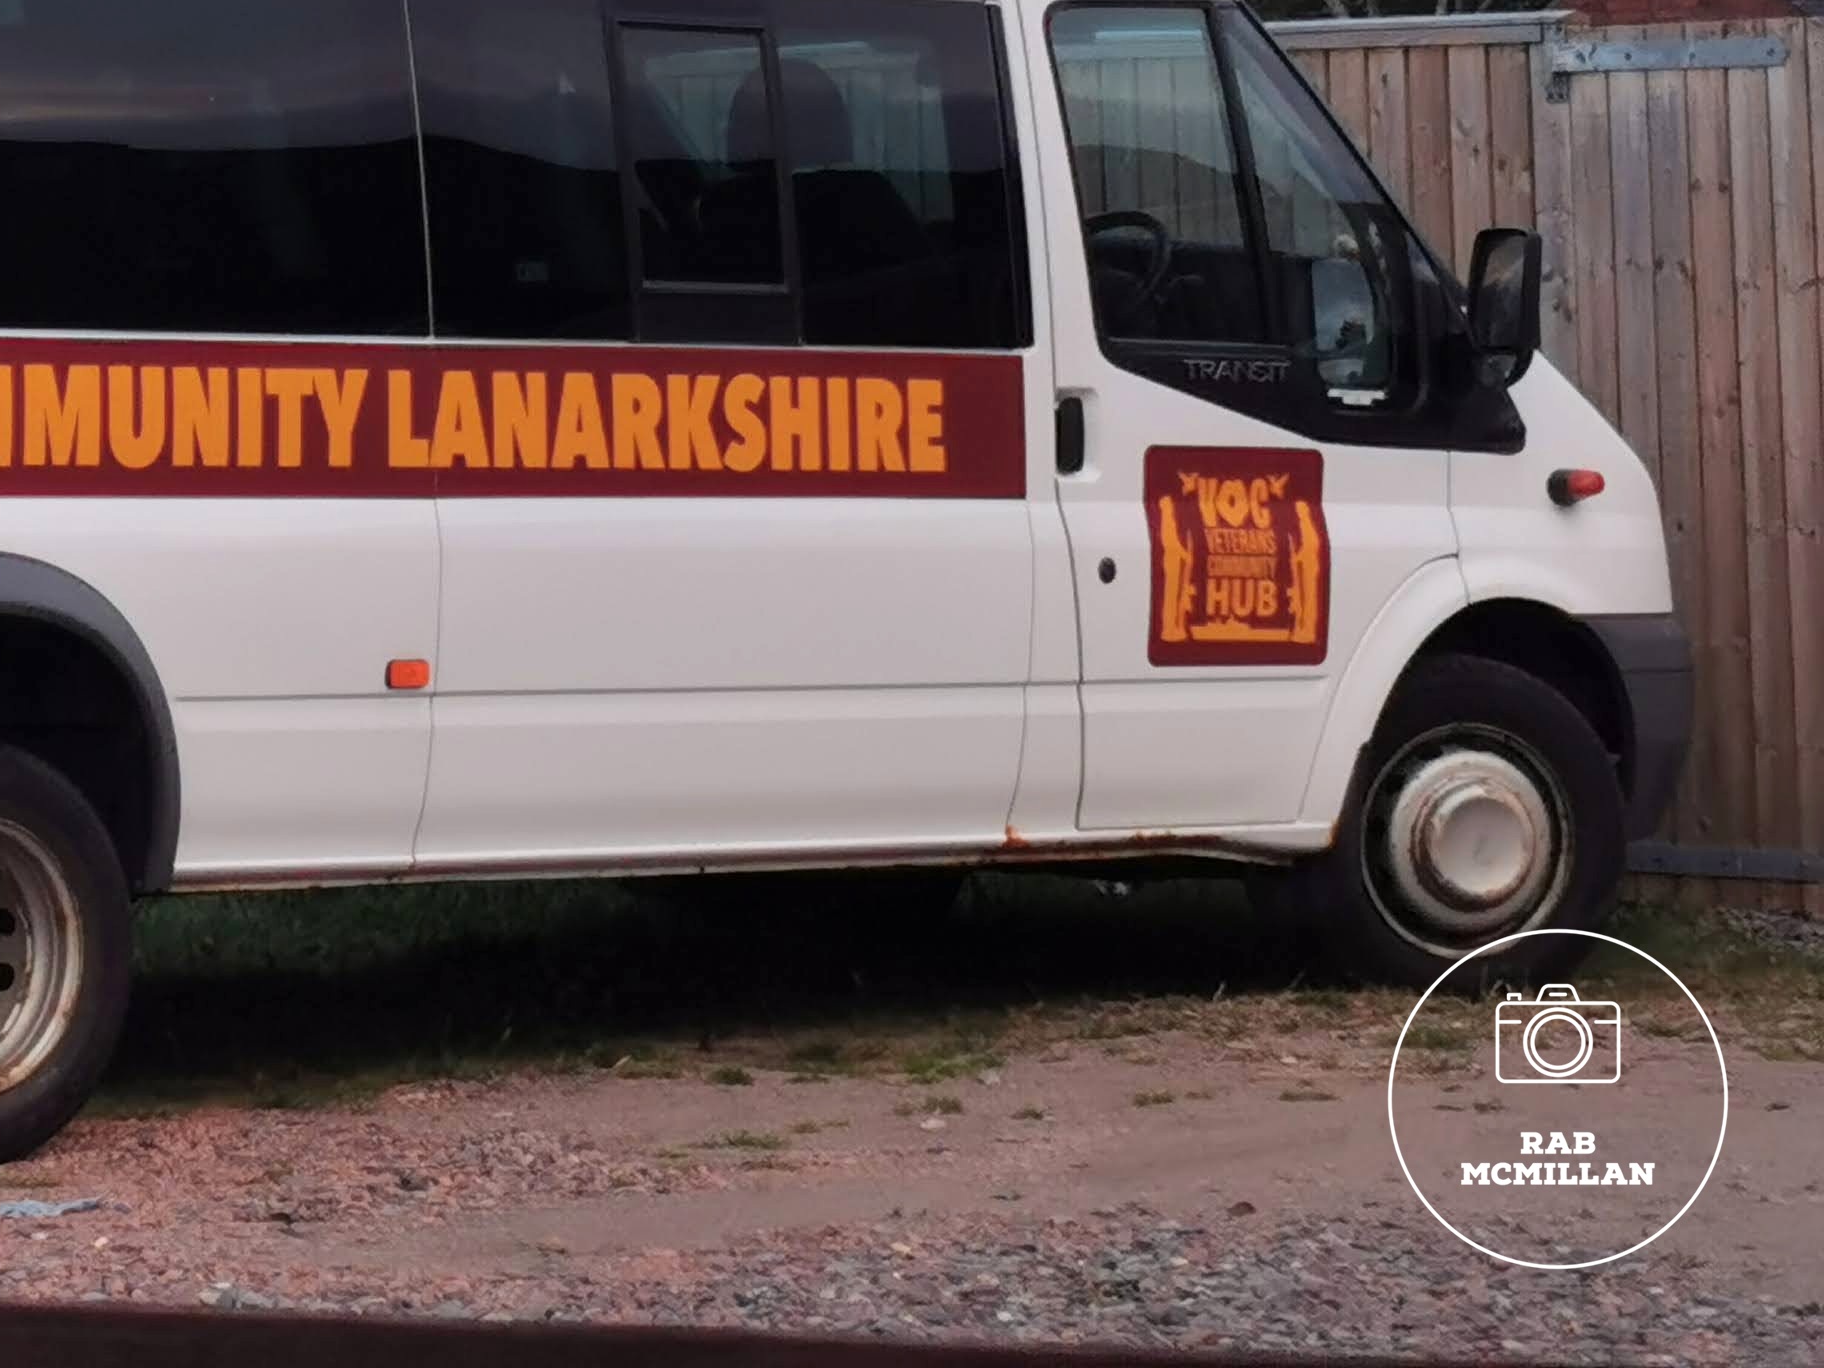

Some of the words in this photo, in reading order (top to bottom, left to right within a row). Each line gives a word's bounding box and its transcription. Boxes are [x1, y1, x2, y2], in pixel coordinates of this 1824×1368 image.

[1184, 358, 1291, 382] TRANSIT
[385, 369, 947, 473] LANARKSHIRE
[1206, 577, 1278, 618] HUB
